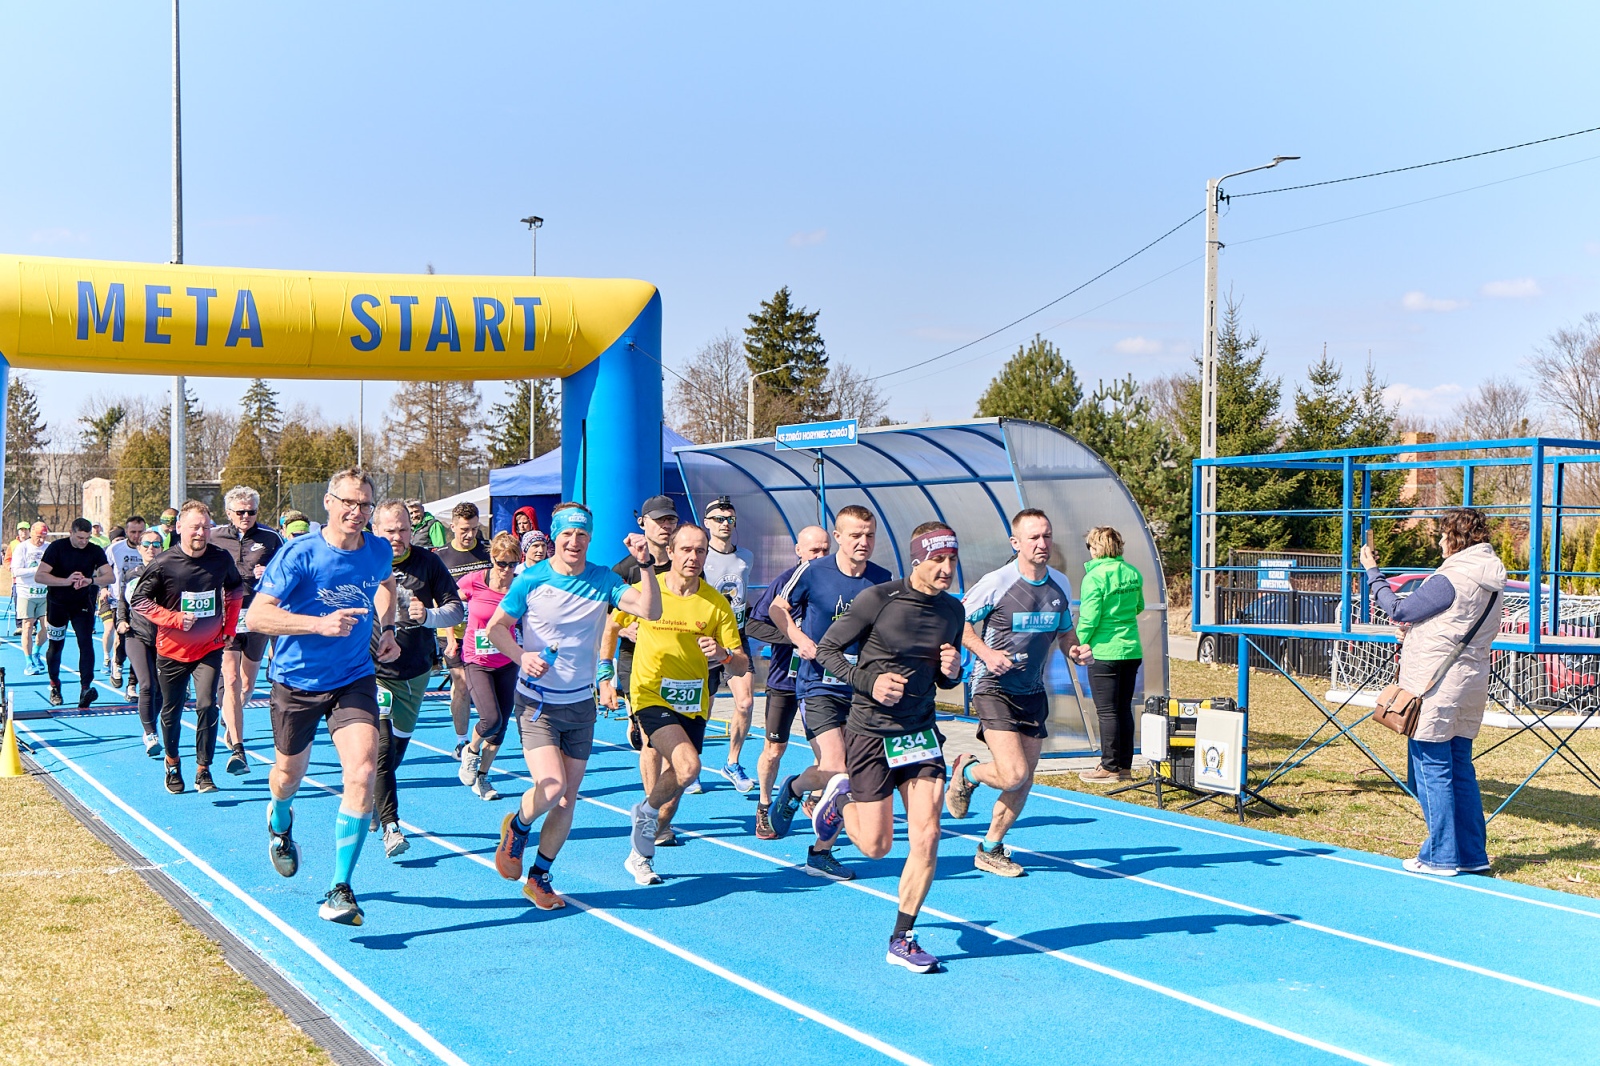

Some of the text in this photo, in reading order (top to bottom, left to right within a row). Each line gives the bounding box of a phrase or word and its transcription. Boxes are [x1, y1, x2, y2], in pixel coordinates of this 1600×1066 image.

[77, 281, 541, 352] META START
[779, 434, 785, 442] KS
[785, 431, 801, 442] ZDRÓJ
[187, 599, 210, 609] 209
[666, 689, 695, 701] 230
[892, 732, 927, 752] 234
